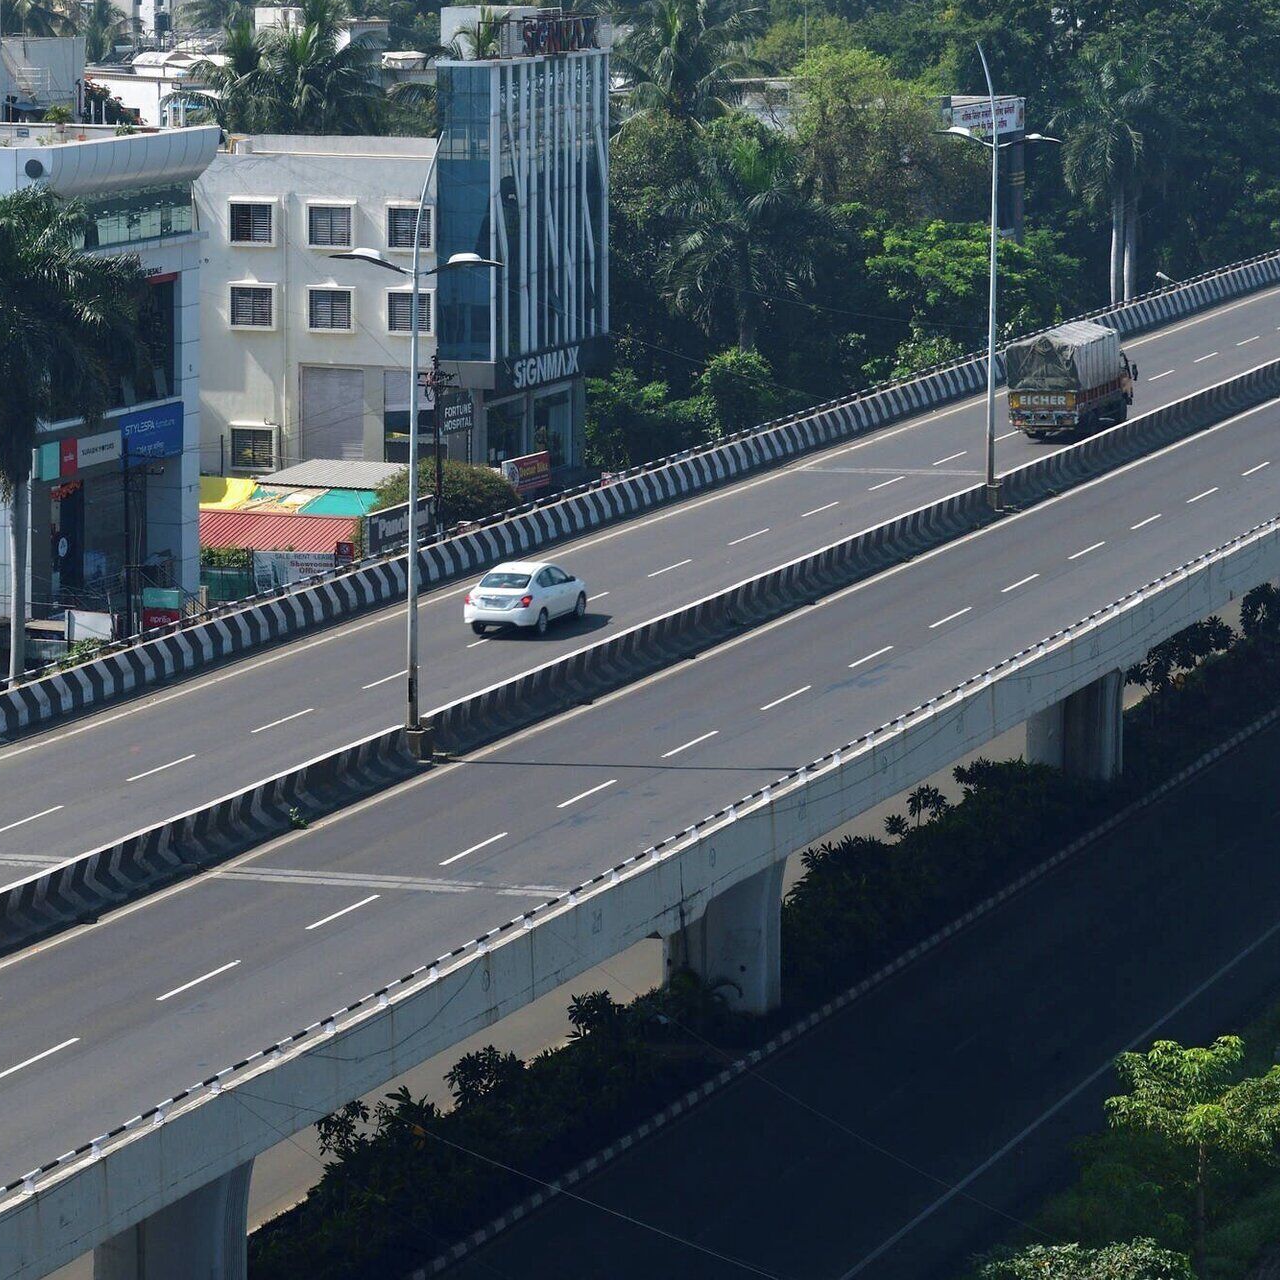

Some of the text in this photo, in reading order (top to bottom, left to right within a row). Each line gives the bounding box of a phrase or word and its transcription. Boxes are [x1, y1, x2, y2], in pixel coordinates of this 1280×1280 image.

[1020, 395, 1066, 405] EICHER
[444, 402, 472, 418] FORTUNE
[124, 419, 155, 435] STYLESPA
[443, 417, 472, 432] HOSPITAL
